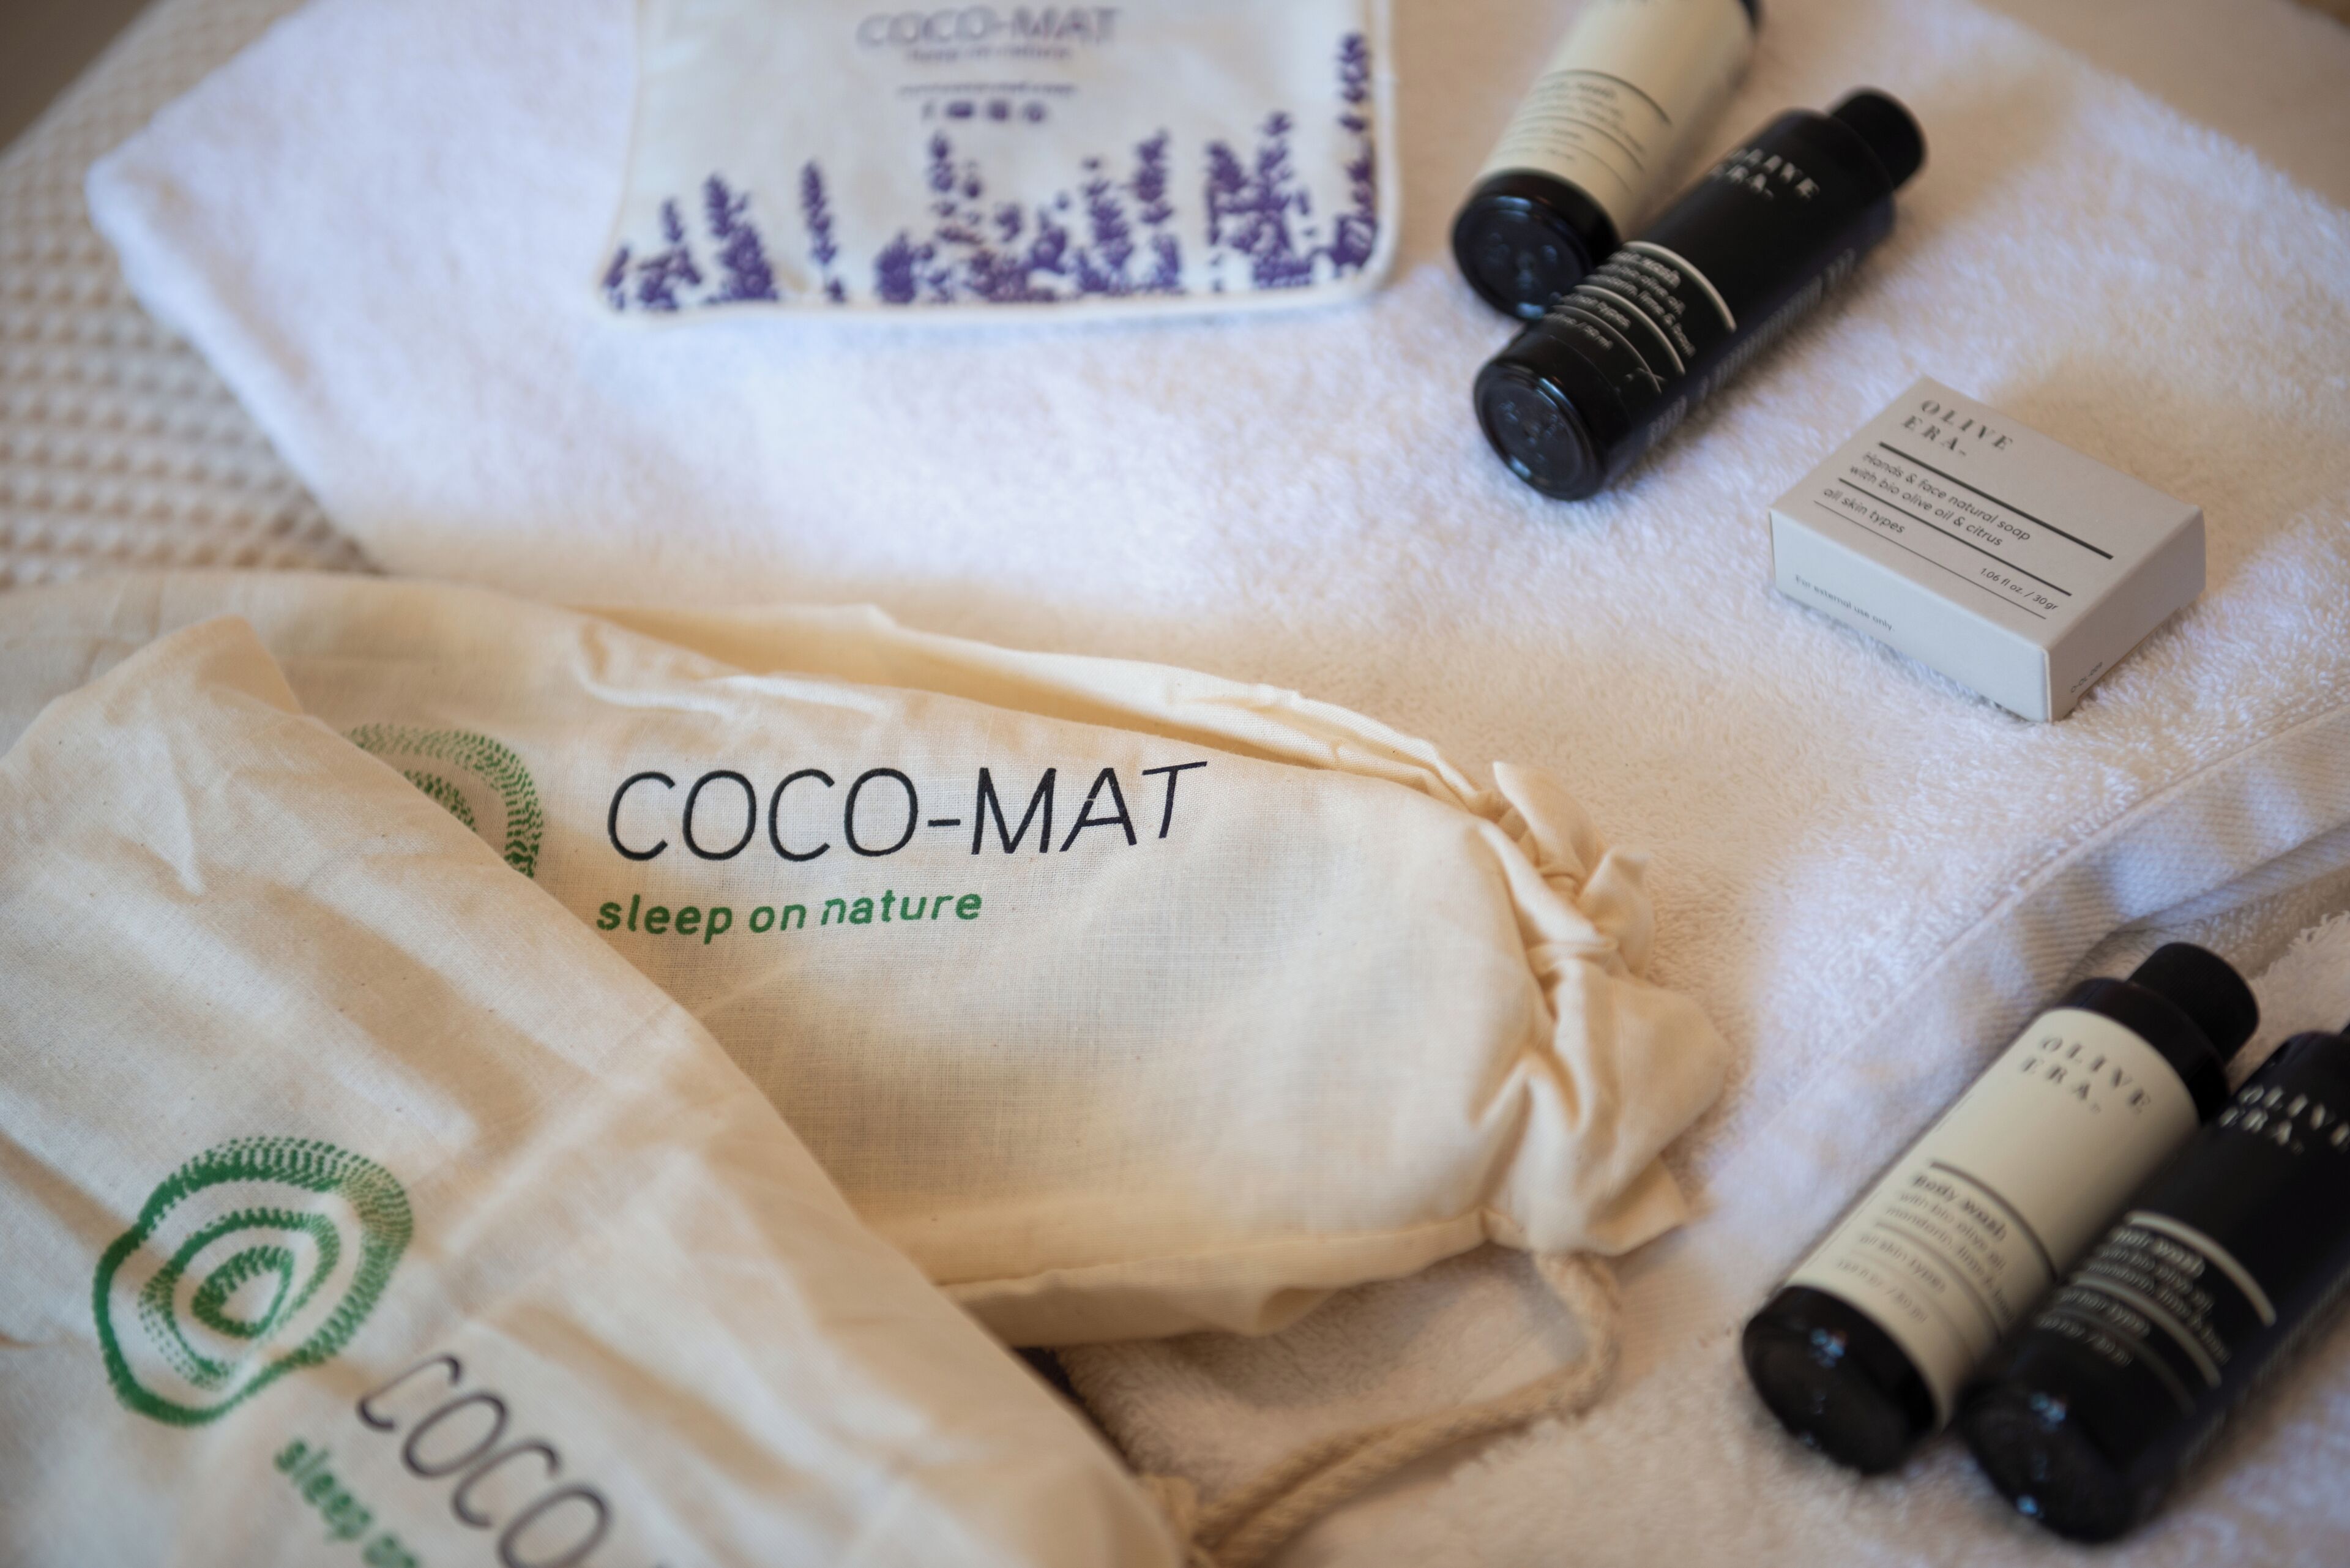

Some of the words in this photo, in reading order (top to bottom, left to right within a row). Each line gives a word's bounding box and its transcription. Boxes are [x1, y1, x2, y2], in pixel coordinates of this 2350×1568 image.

[1920, 399, 2013, 451] OLIVE
[1823, 488, 1843, 501] all
[1841, 496, 1868, 515] skin
[1869, 509, 1906, 534] types
[1849, 465, 1877, 484] with
[1879, 478, 1900, 495] bio
[1902, 490, 1933, 511] olive
[1934, 506, 1954, 521] oil
[1953, 517, 1966, 528] &
[1966, 523, 2003, 547] citrus
[1863, 452, 1904, 478] Hands
[1906, 472, 1918, 484] &
[1918, 479, 1947, 499] face
[1948, 496, 1999, 525] natural
[1997, 520, 2031, 541] soap
[1980, 567, 2001, 582] 1.06
[607, 761, 1208, 862] COCO-MAT
[597, 894, 733, 944] sleep
[748, 900, 807, 934] on
[820, 889, 983, 928] nature
[2040, 1037, 2151, 1116] OLIVE
